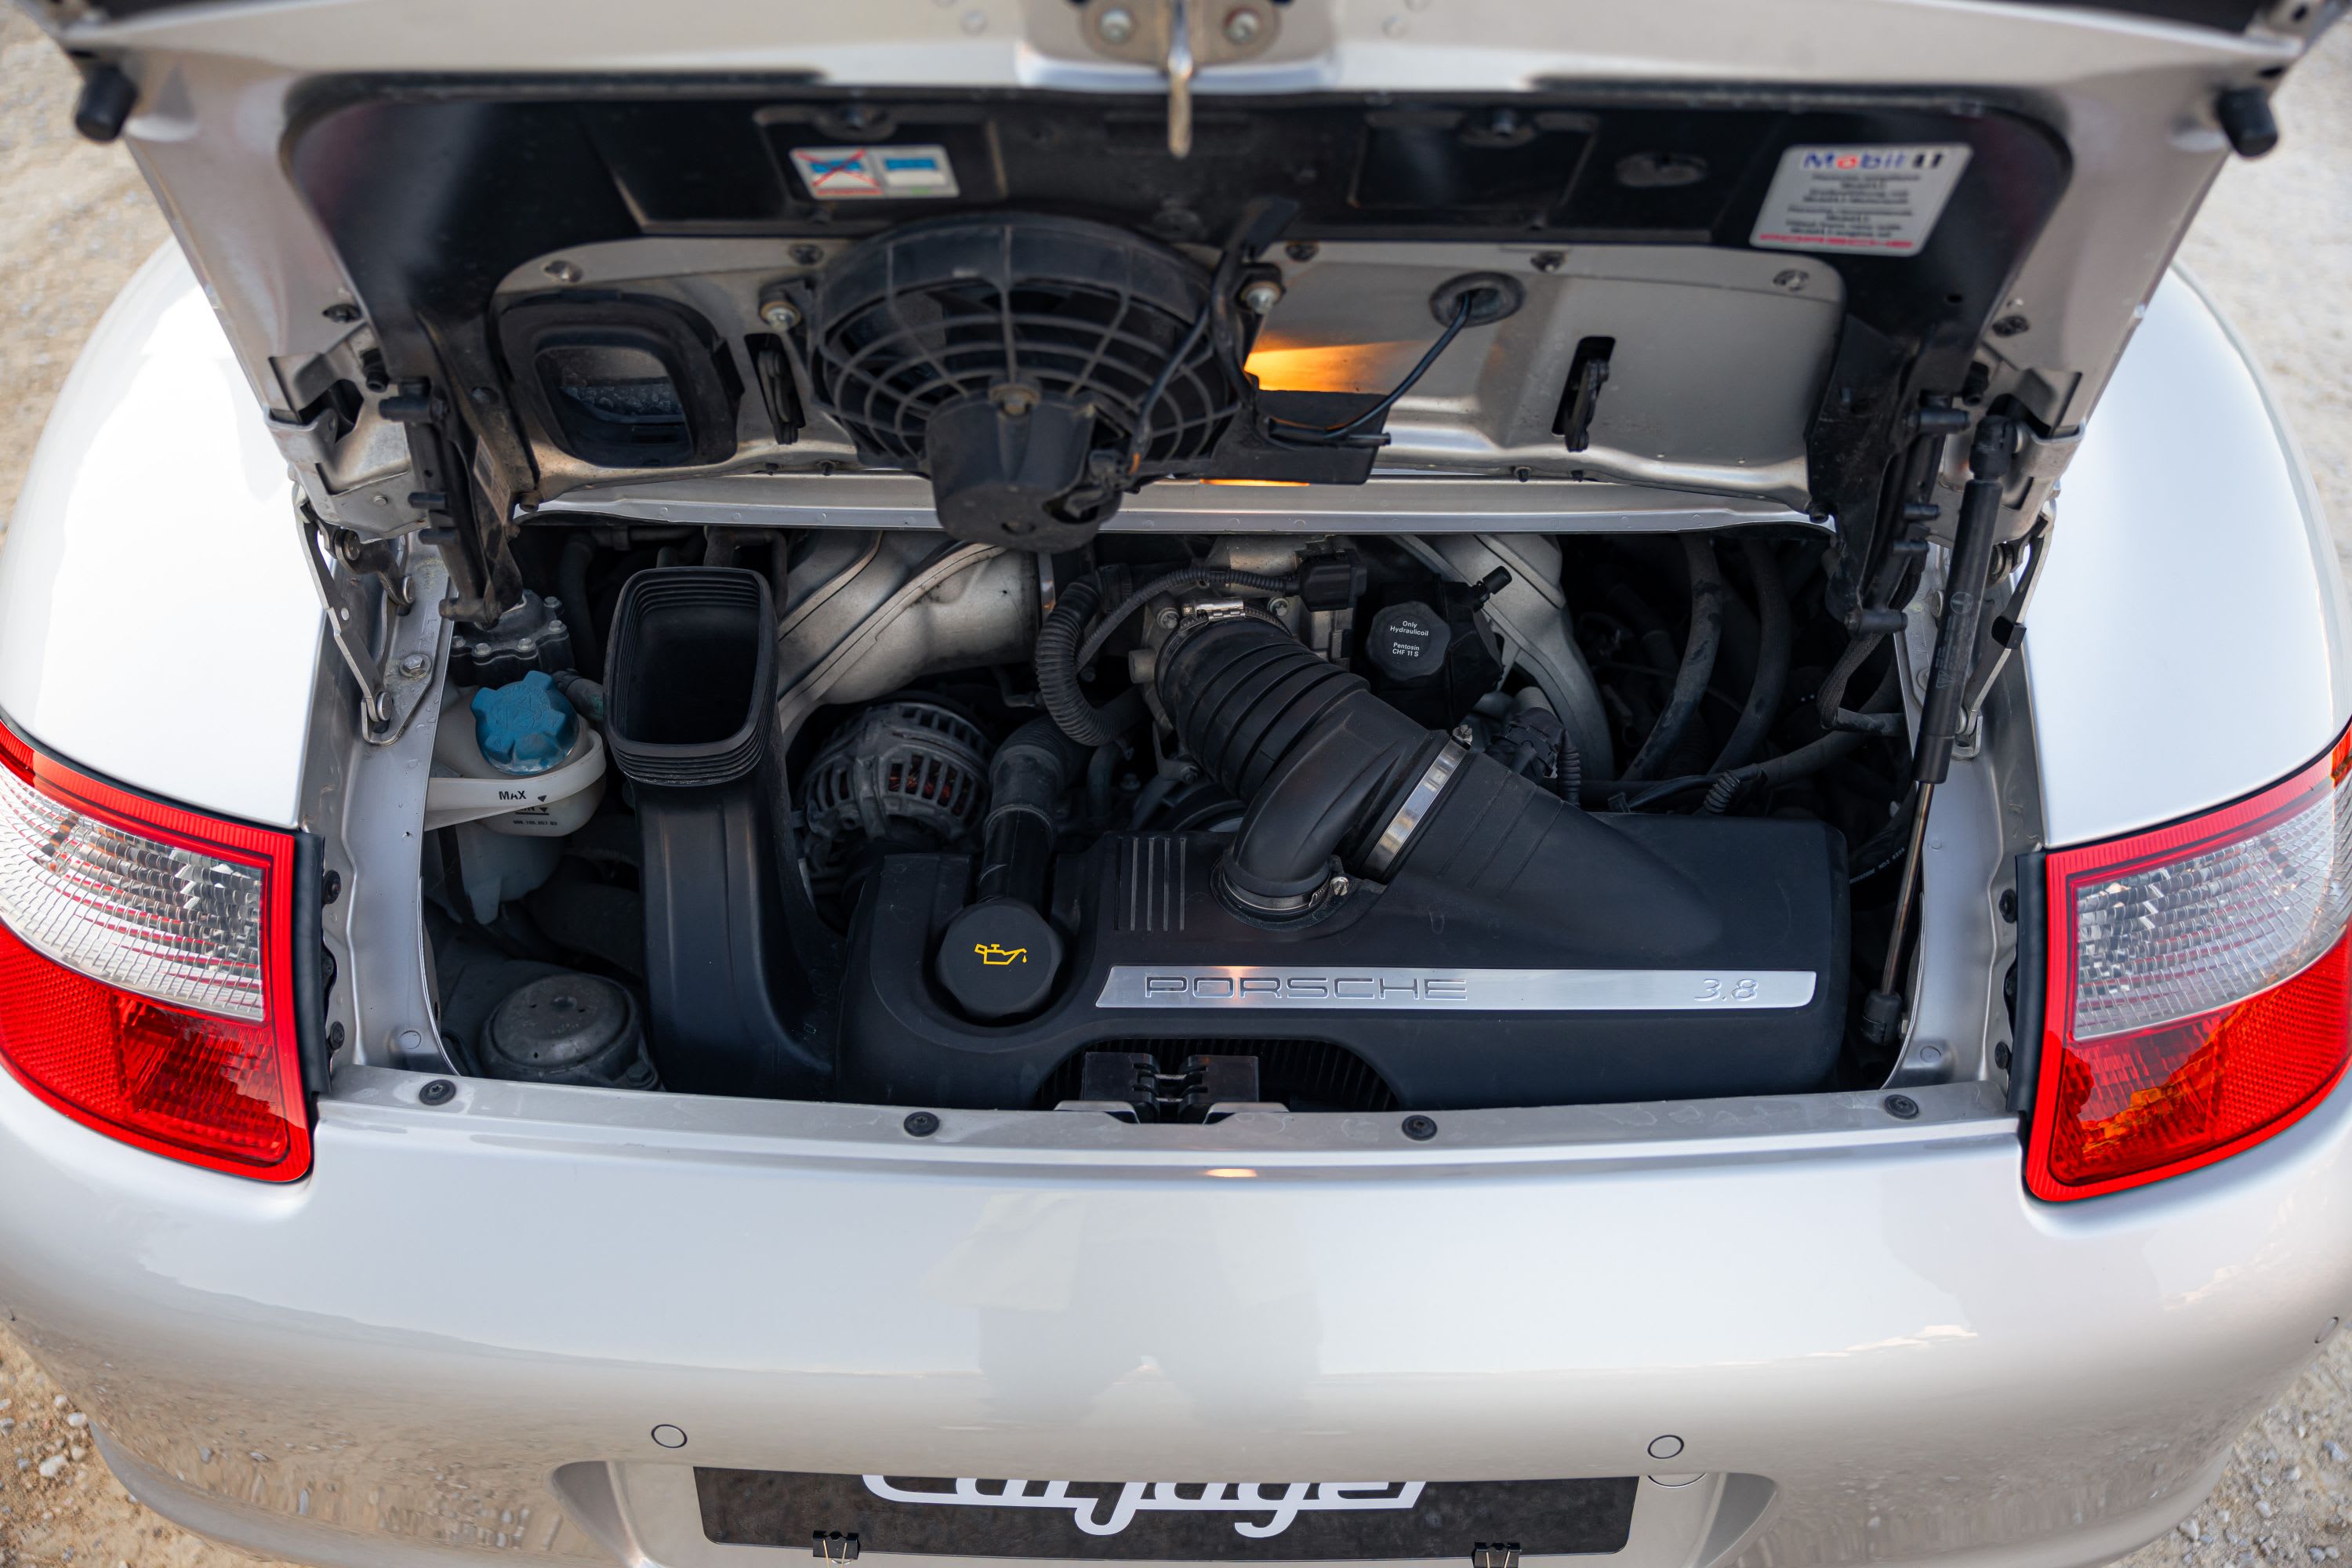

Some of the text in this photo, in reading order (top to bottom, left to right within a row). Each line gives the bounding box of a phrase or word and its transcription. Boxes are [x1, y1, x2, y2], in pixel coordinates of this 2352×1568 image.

[1803, 152, 1905, 169] Mobil
[1390, 626, 1428, 636] Hydraulicoil
[1393, 642, 1419, 651] Pentosin
[499, 790, 527, 800] MAX
[1145, 976, 1759, 1002] PORSCHE 3.8
